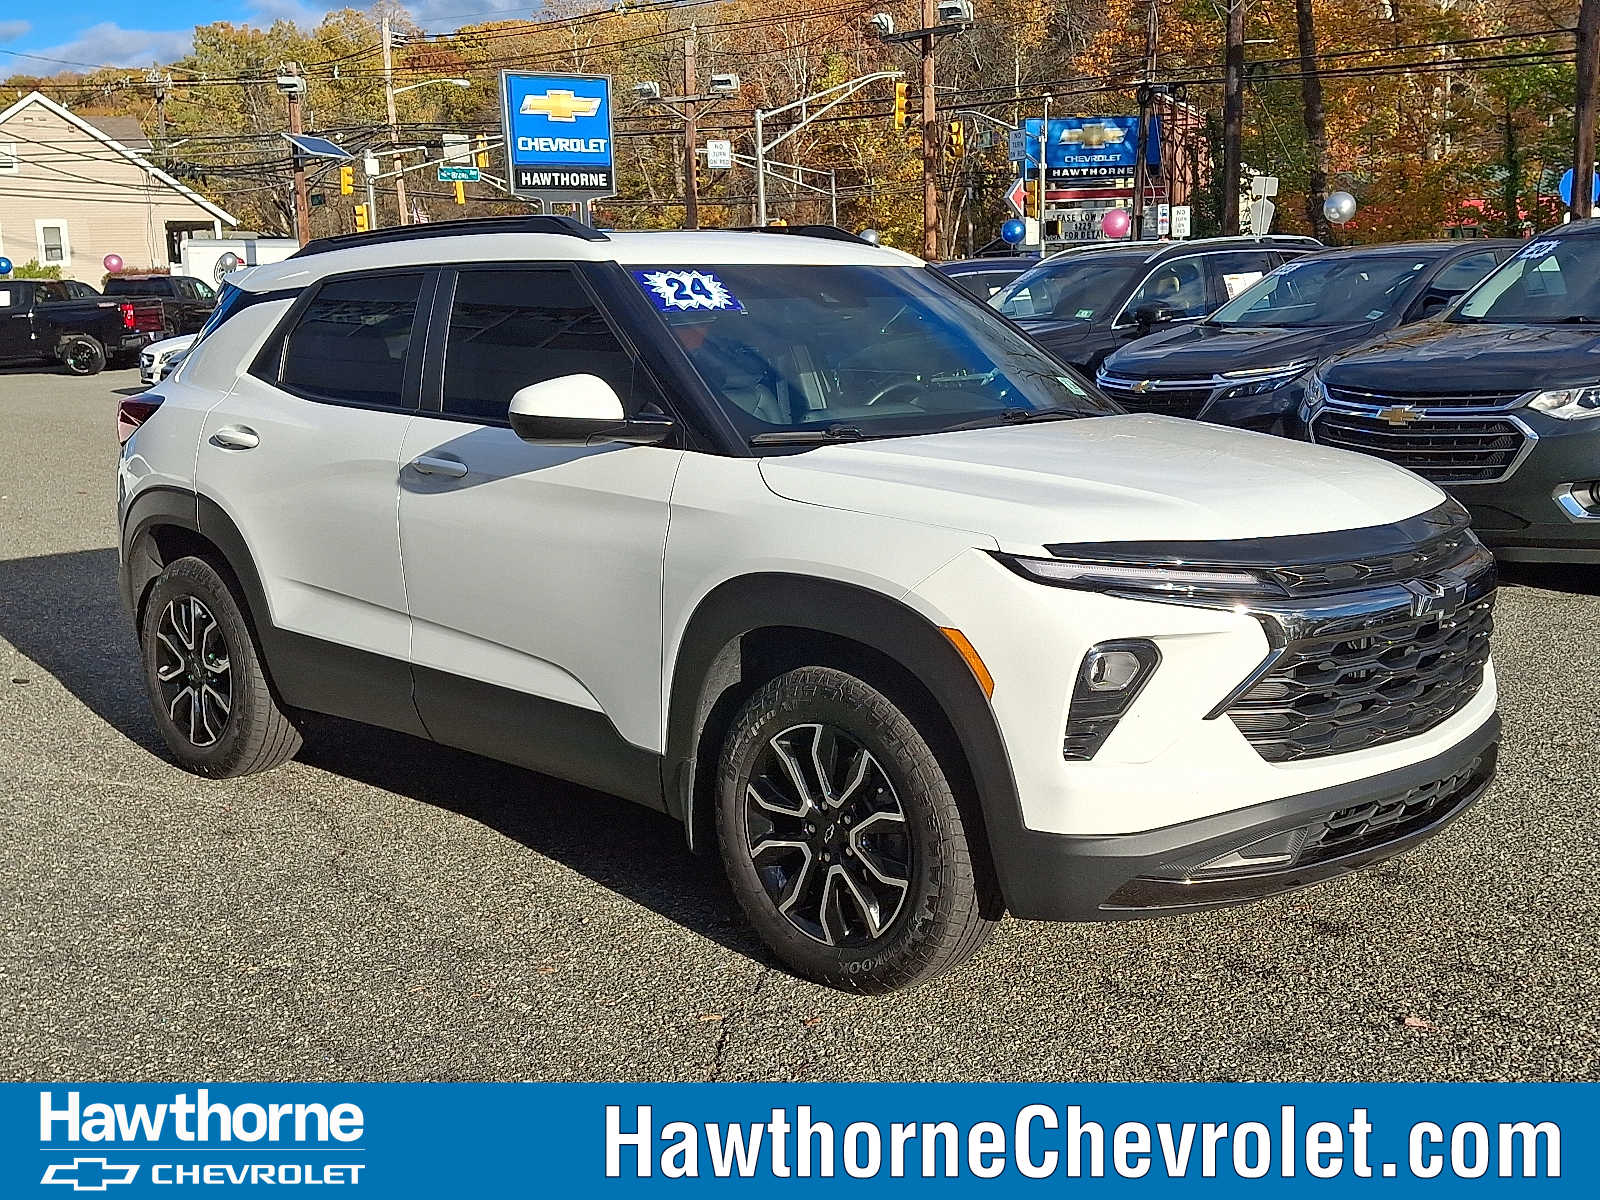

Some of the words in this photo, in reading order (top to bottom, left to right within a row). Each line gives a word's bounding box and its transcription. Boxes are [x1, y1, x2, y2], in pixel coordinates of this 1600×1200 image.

[517, 137, 607, 153] CHEVROLET
[1064, 154, 1122, 163] CHEVROLET
[1052, 167, 1134, 177] HAWTHORNE
[522, 172, 608, 187] HAWTHORNE
[1080, 213, 1097, 221] LOW
[1064, 231, 1079, 240] FOR
[665, 277, 713, 300] 24
